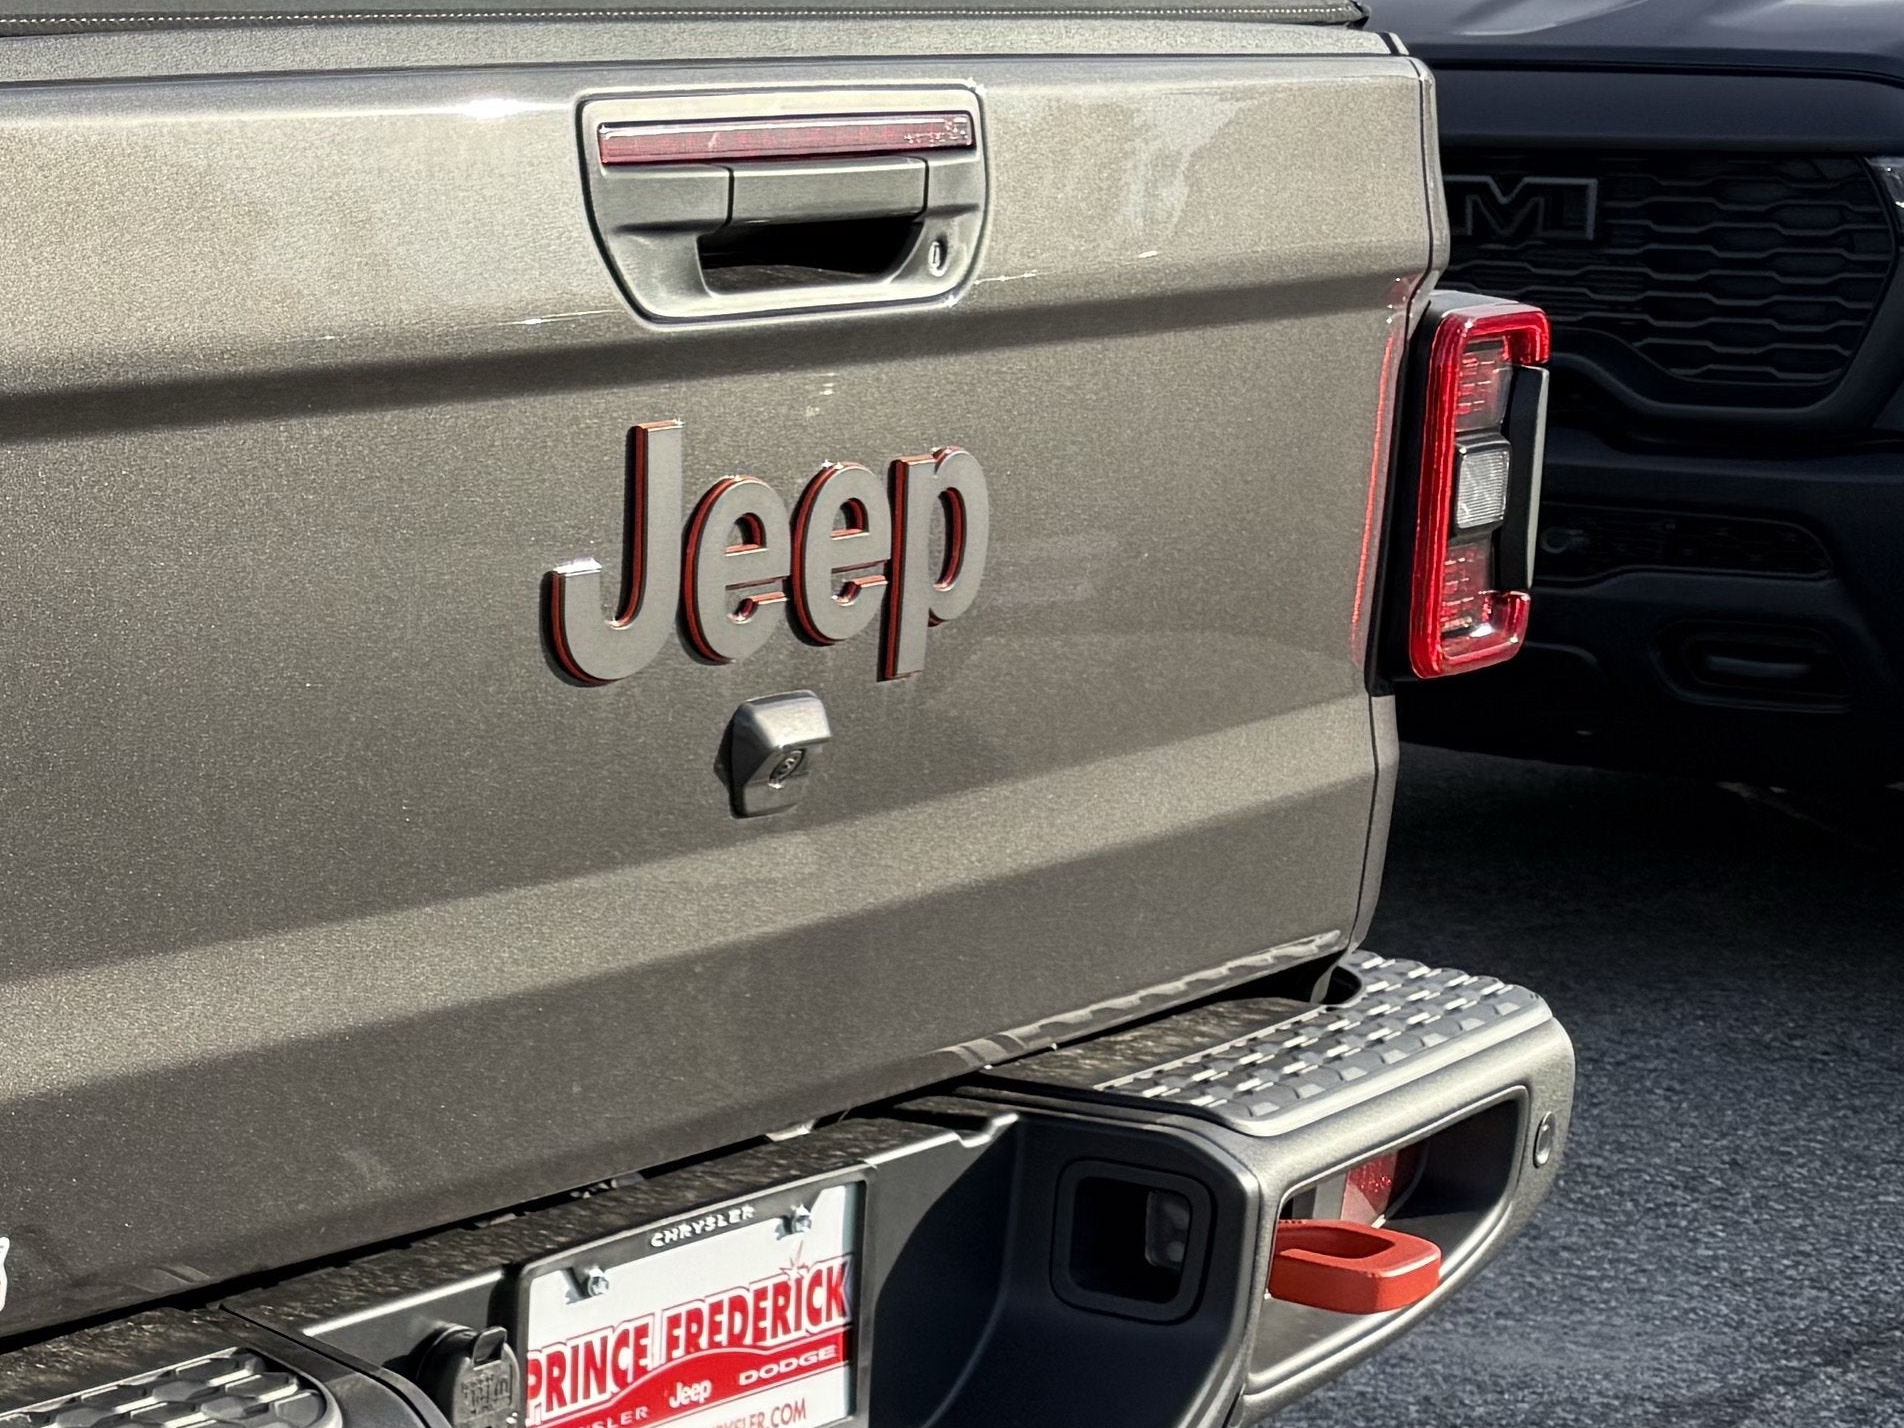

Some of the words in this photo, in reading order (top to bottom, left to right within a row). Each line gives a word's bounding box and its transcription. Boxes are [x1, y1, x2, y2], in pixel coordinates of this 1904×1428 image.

[545, 419, 990, 685] Jeep
[650, 1204, 755, 1248] CHRYSLER
[527, 1322, 650, 1413] PRINCE
[665, 1262, 847, 1364] FREDERICK
[669, 1379, 712, 1408] Jeep
[738, 1344, 837, 1386] DODGE
